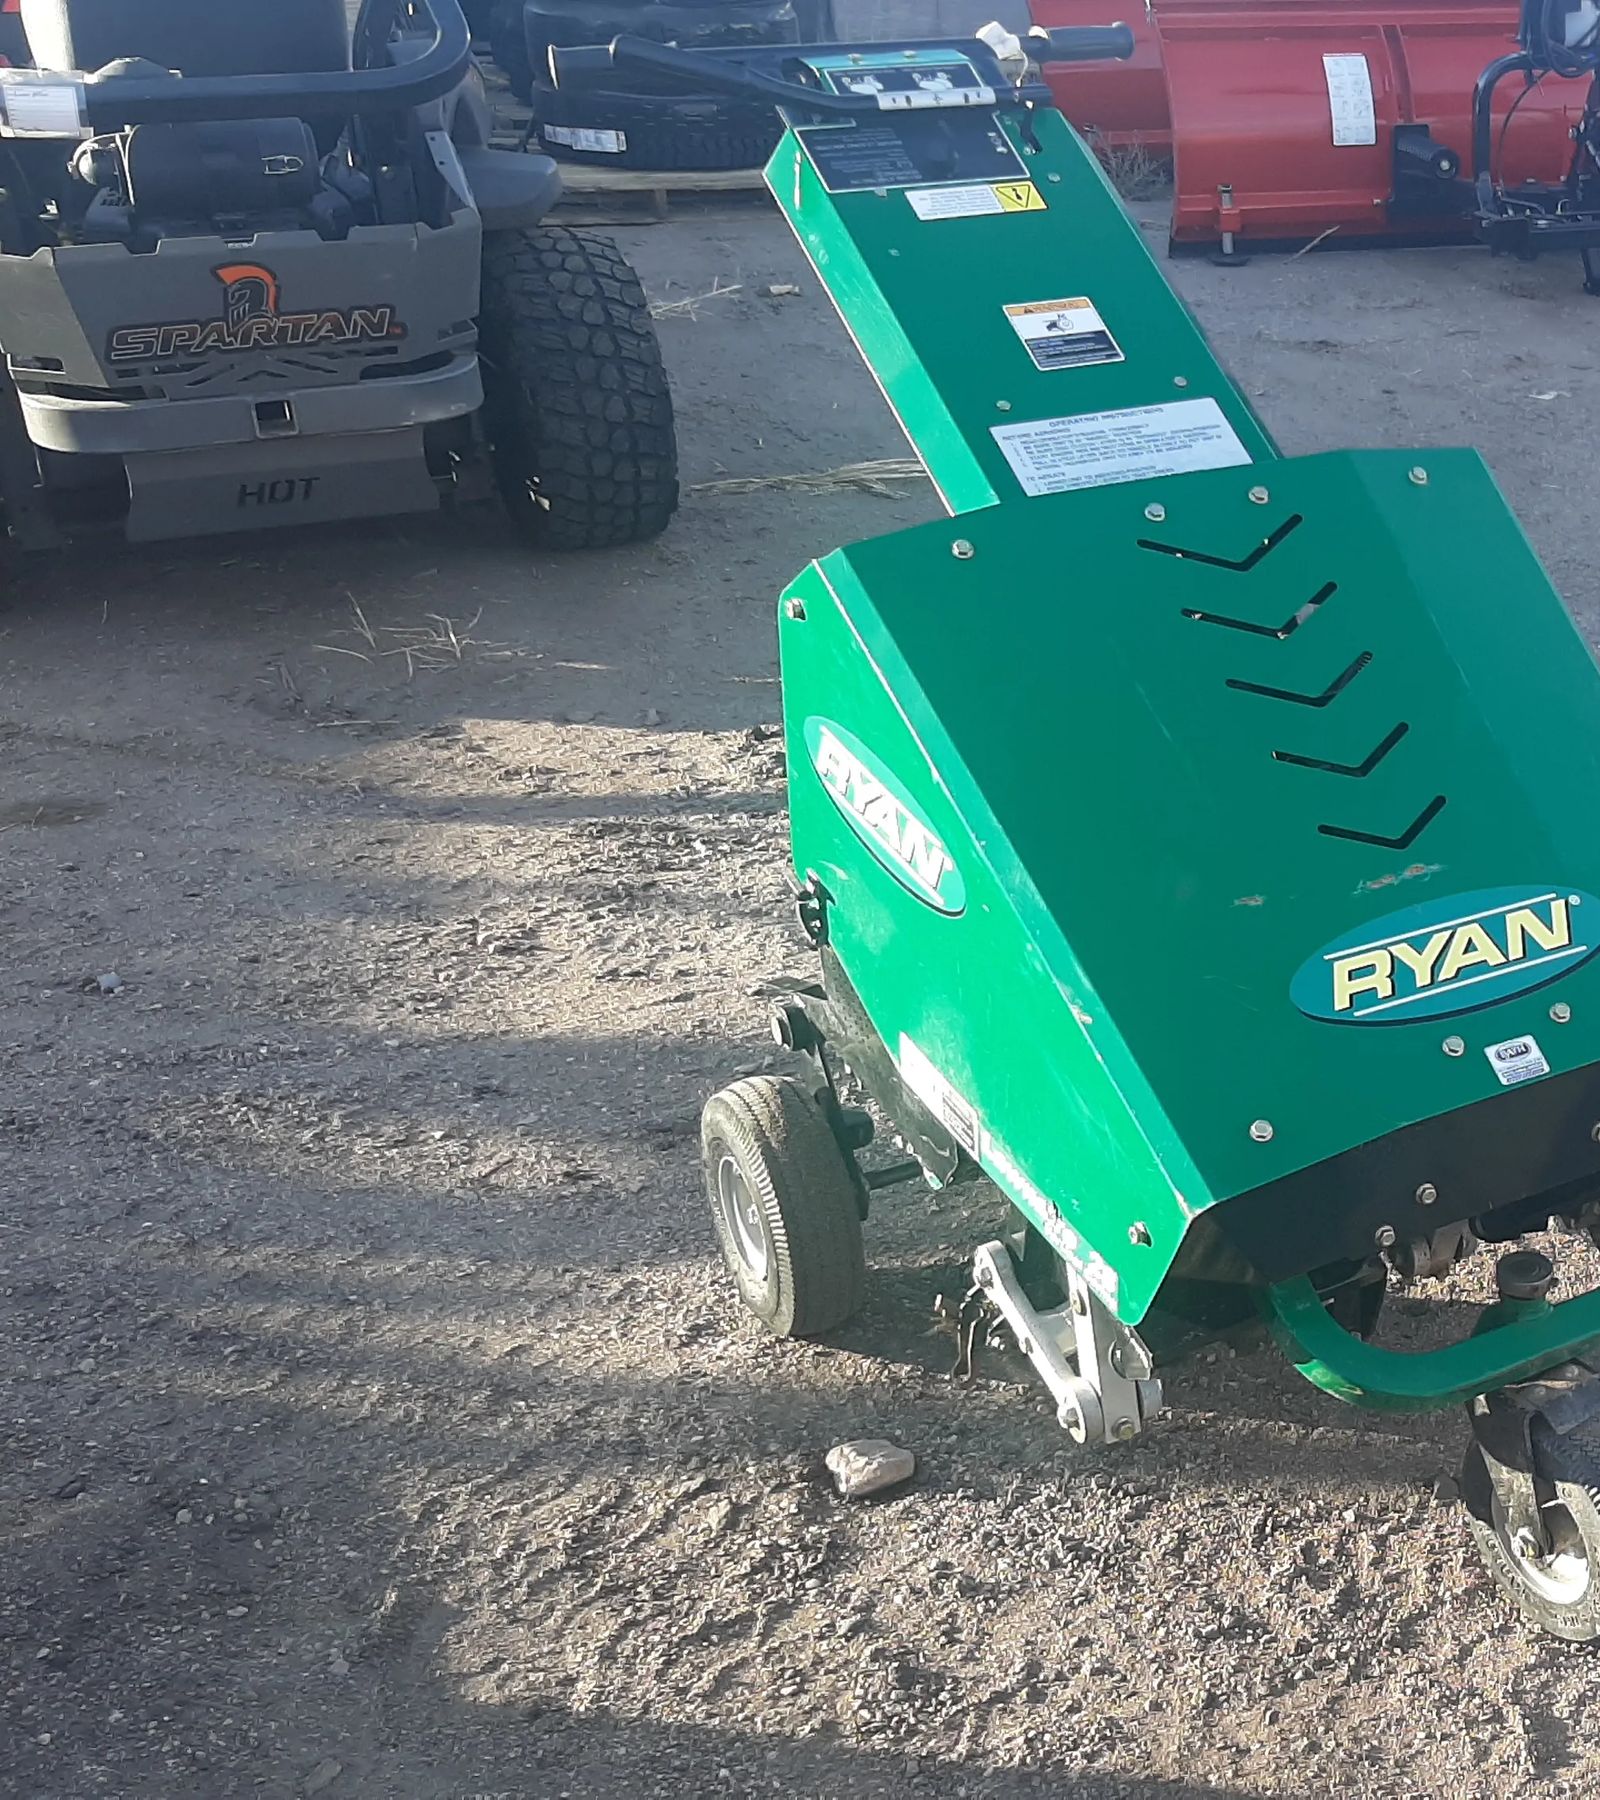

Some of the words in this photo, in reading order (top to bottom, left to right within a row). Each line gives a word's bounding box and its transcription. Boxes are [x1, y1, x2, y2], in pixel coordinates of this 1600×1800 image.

[111, 308, 391, 360] SPARTAN
[237, 476, 321, 508] HOT
[815, 732, 950, 893] RYAN
[1332, 898, 1571, 1013] RYAN
